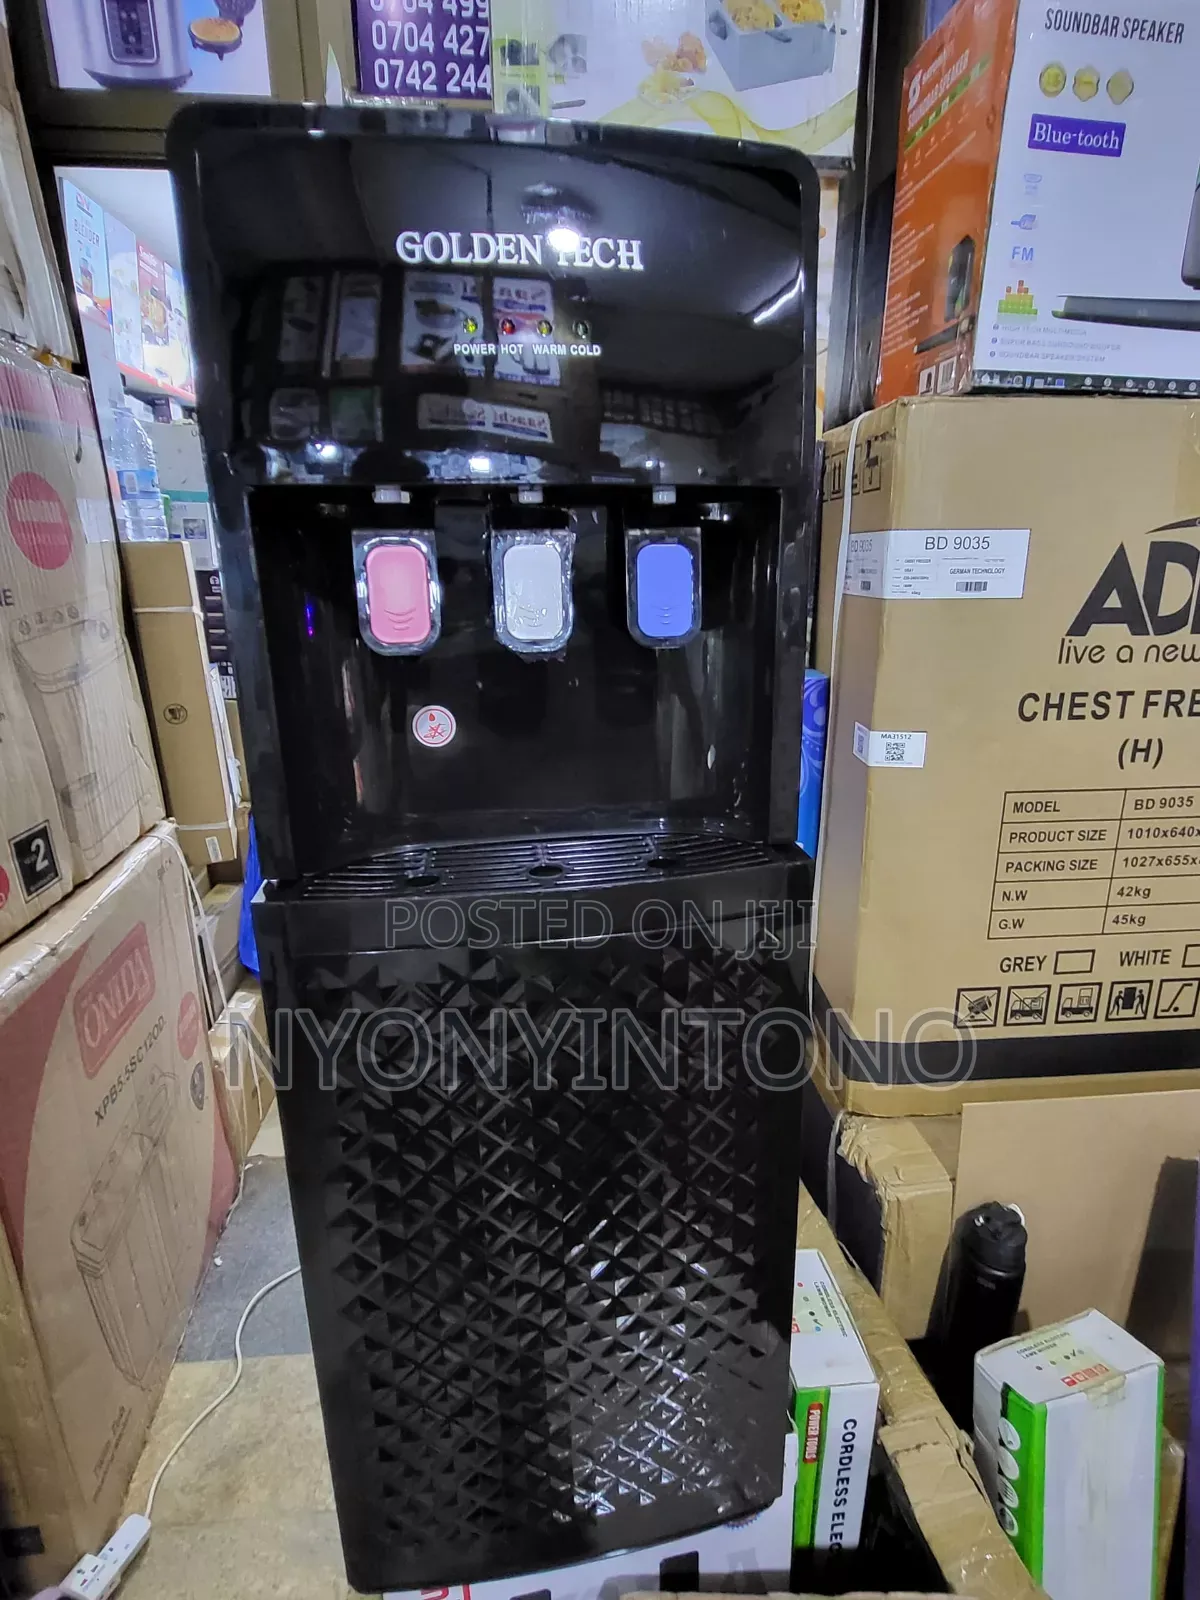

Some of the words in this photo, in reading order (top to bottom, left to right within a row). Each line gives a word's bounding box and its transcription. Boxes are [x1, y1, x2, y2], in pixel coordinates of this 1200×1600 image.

[1044, 8, 1120, 38] SOUNDBAR
[1121, 17, 1185, 44] SPEAKER
[371, 19, 435, 54] 0704
[443, 23, 490, 57] 427
[374, 58, 437, 92] 0742
[445, 62, 492, 95] 244
[1033, 122, 1120, 149] Blue-tooth
[73, 218, 100, 247] BLENDER
[396, 231, 543, 265] GOLDEN
[1011, 246, 1034, 261] FM
[453, 343, 496, 355] POWER
[501, 343, 524, 355] HOT
[532, 343, 567, 356] WARM
[570, 344, 601, 356] COLD
[925, 536, 948, 550] BD
[953, 536, 991, 550] 9035
[949, 567, 971, 575] GERMAN
[971, 567, 1006, 575] TECHNOLOGY
[0, 587, 15, 607] E
[1064, 541, 1200, 636] AD
[1058, 637, 1106, 664] live
[1116, 645, 1134, 663] a
[1018, 690, 1135, 722] CHEST
[1118, 737, 1164, 770] (H)
[1012, 801, 1061, 813] MODEL
[1134, 798, 1155, 811] BD
[1159, 796, 1194, 809] 9035
[1009, 830, 1074, 844] PRODUCT
[1077, 829, 1107, 841] SIZE
[30, 838, 49, 872] 2
[1005, 860, 1065, 873] PACKING
[1069, 859, 1098, 871] SIZE
[1122, 855, 1200, 868] 1027x655x
[1001, 890, 1028, 901] N.W
[1116, 886, 1151, 899] 42kg
[998, 918, 1024, 930] G.W
[1112, 914, 1146, 927] 45kg
[1000, 955, 1047, 973] GREY
[1119, 949, 1172, 966] WHITE
[807, 1409, 821, 1436] POWER
[805, 1437, 818, 1459] TOOLS
[833, 1418, 858, 1507] CORDLESS
